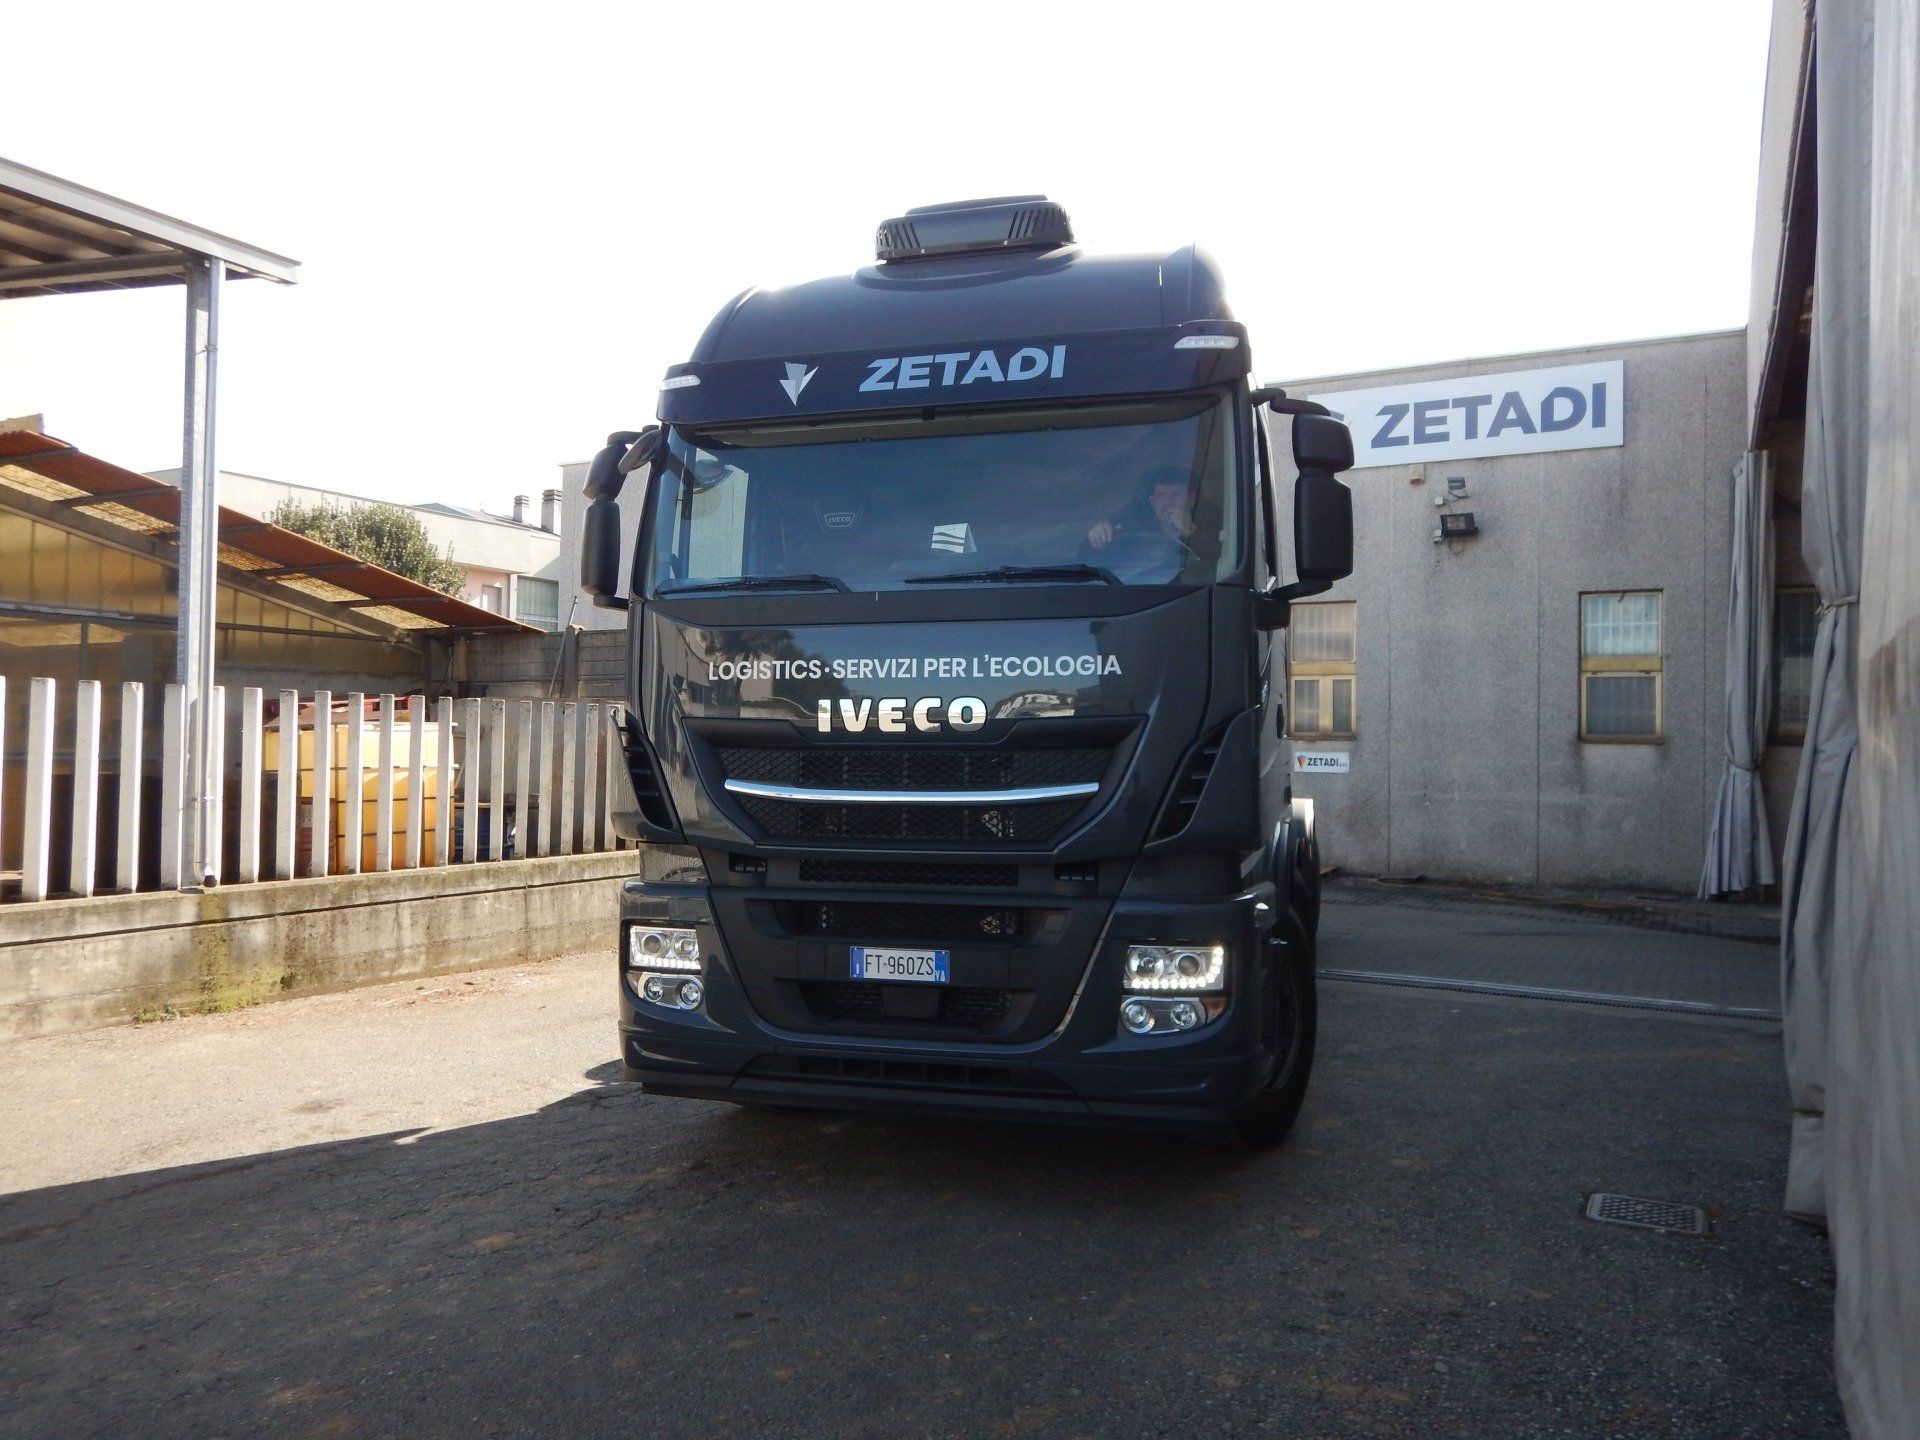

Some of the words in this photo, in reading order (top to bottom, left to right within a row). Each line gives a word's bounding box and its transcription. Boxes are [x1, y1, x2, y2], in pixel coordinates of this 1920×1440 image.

[858, 344, 1067, 392] ZETADI
[1371, 382, 1606, 448] ZETADI
[924, 657, 966, 677] PER
[973, 654, 1122, 677] L'ECOLOGIA
[817, 697, 987, 733] IVECO
[1308, 758, 1338, 766] ZETADI
